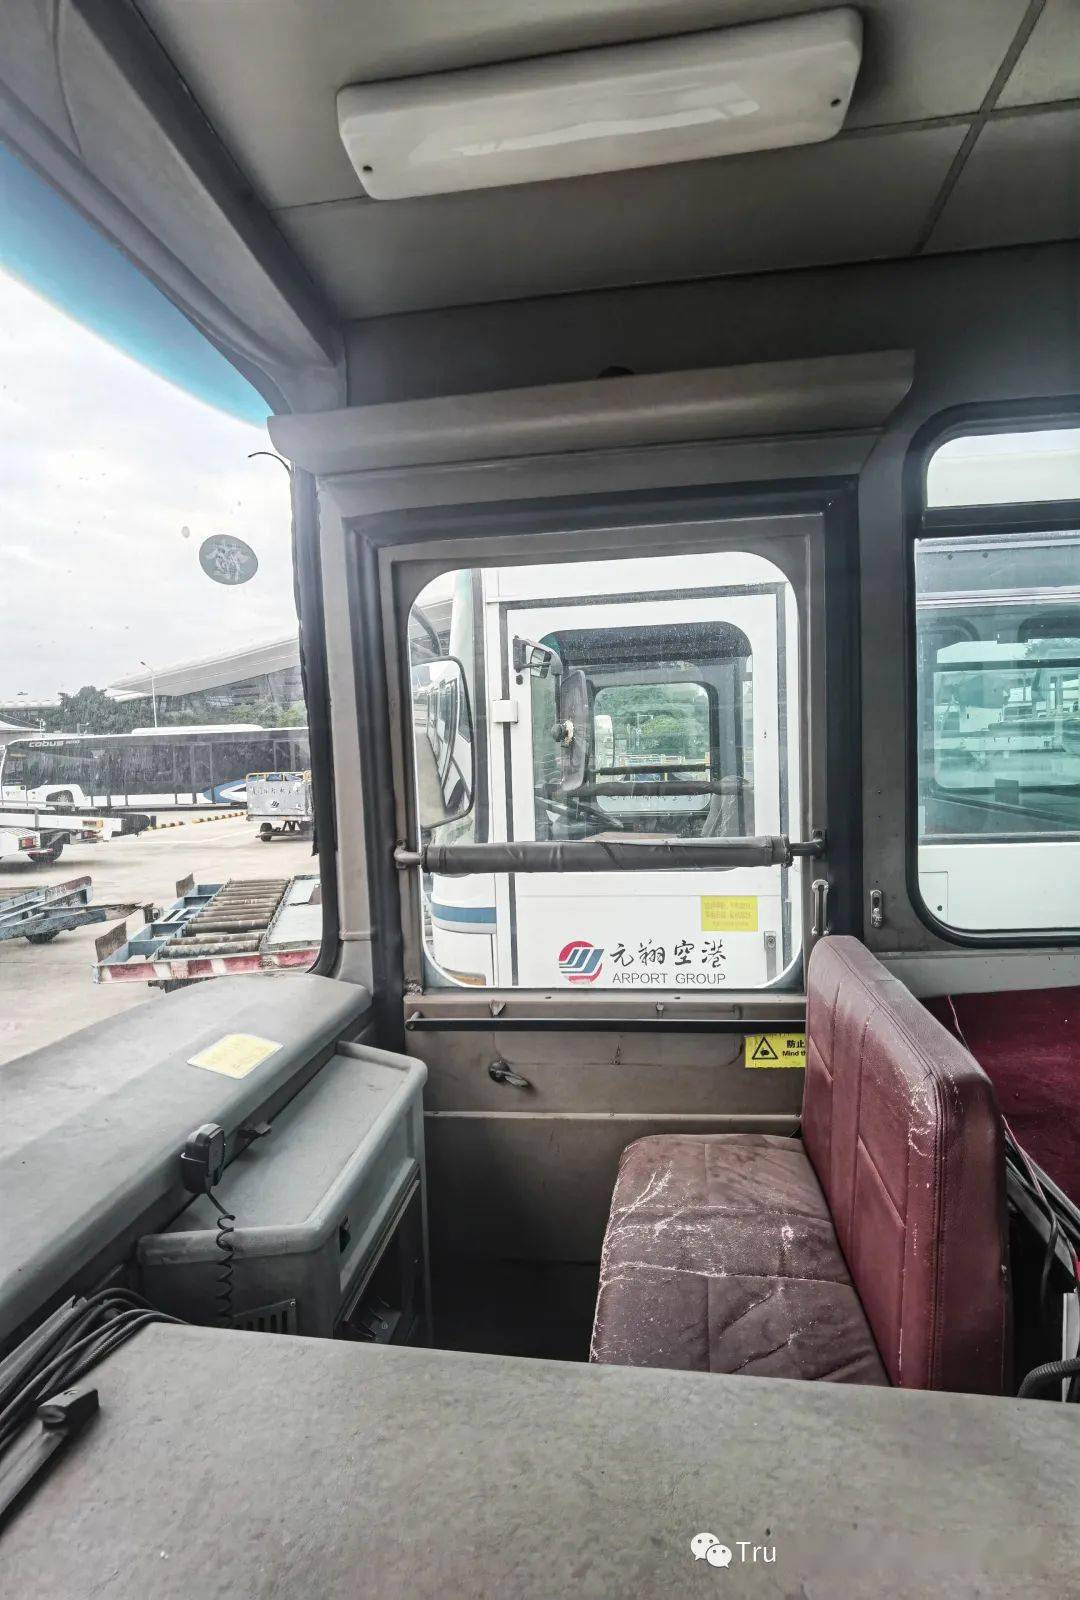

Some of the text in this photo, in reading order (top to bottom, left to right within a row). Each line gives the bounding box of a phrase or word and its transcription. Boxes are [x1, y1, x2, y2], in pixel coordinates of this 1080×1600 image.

[609, 938, 727, 968] 元翔空港
[612, 972, 726, 984] ARPORT GROUP
